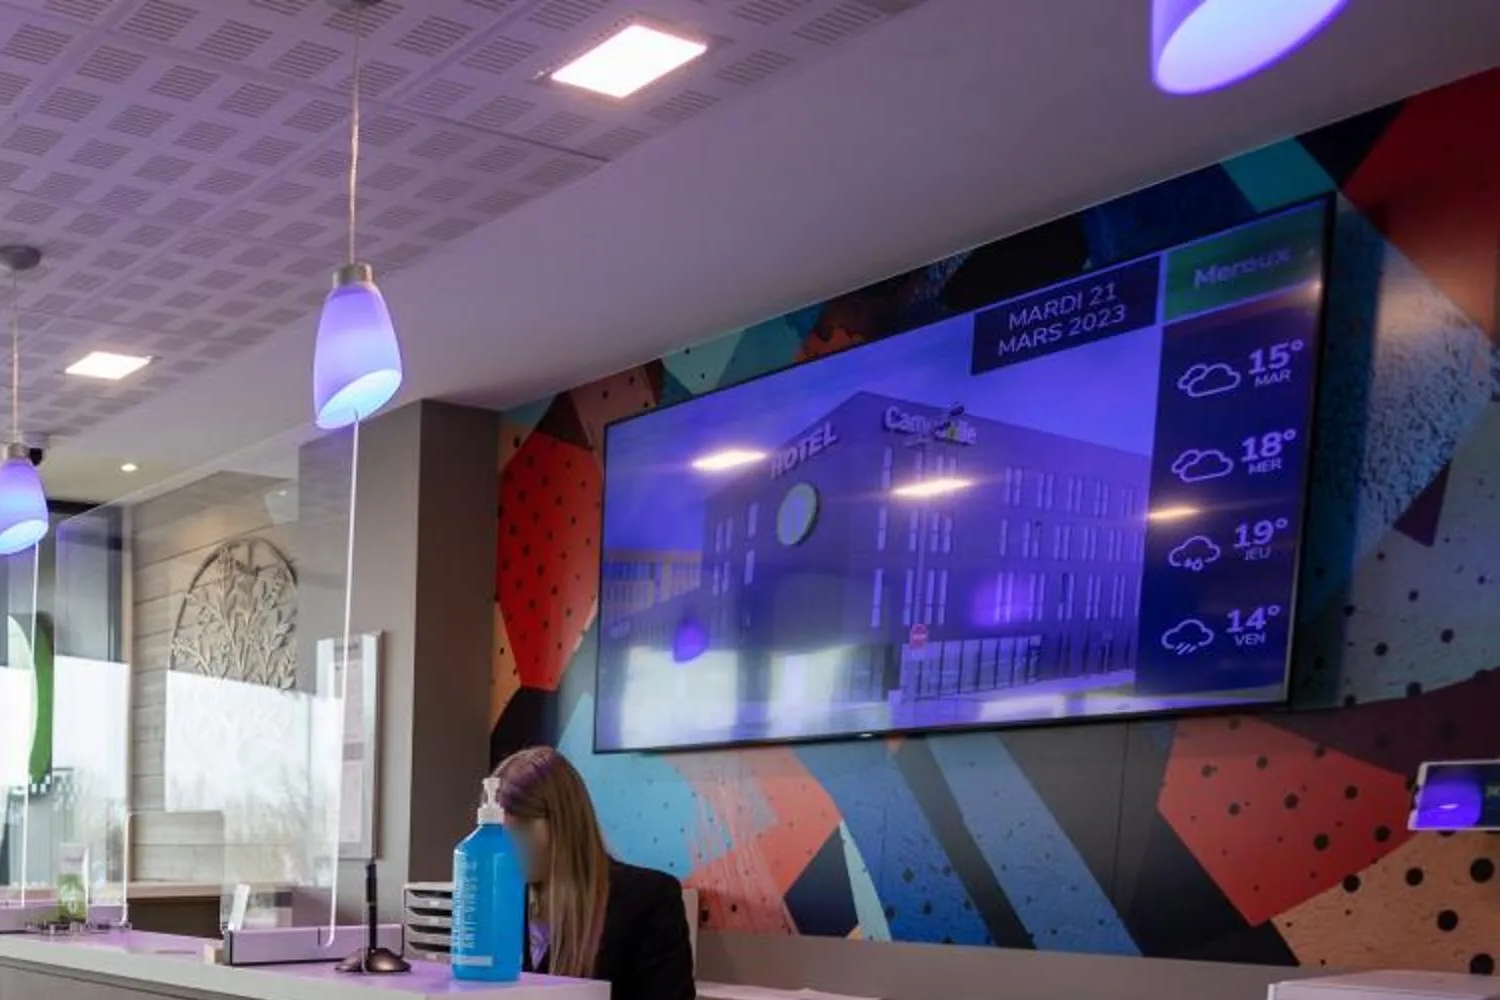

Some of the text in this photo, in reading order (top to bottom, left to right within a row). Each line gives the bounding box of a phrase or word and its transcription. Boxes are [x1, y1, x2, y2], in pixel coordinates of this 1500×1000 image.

[1193, 247, 1292, 289] Meroux
[1008, 281, 1118, 331] MARDI 21
[998, 303, 1127, 357] MARS 2023
[1248, 339, 1304, 375] 15°
[1254, 369, 1292, 388] MAR
[770, 422, 838, 479] HOTEL
[1241, 428, 1297, 462] 18°
[1247, 458, 1282, 475] MER
[1233, 517, 1289, 548] 19°
[1225, 604, 1281, 633] 14°
[1234, 632, 1266, 646] VEN
